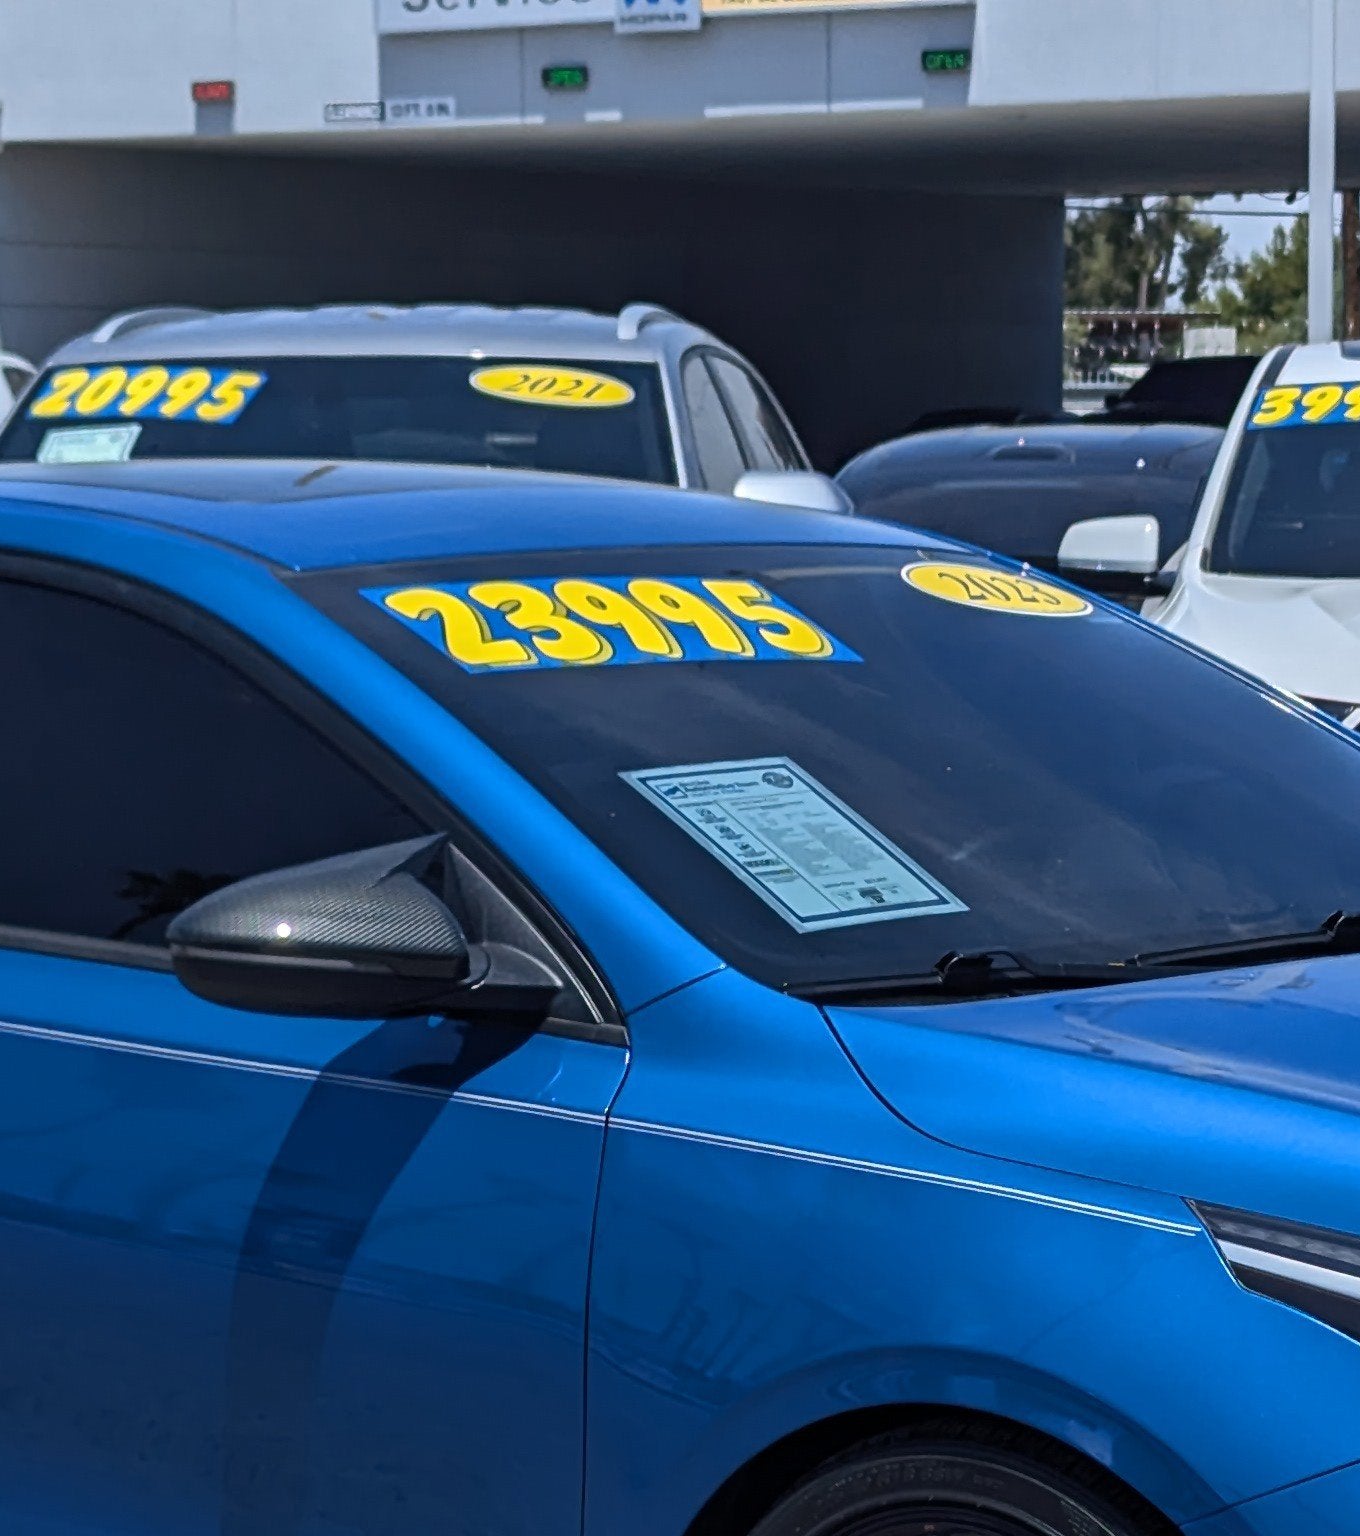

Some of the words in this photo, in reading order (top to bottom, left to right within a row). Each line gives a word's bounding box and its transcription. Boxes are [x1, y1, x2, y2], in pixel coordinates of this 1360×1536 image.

[30, 366, 262, 422] 20995
[502, 373, 605, 399] 2021
[937, 571, 1062, 606] 2023
[384, 578, 835, 665] 23995
